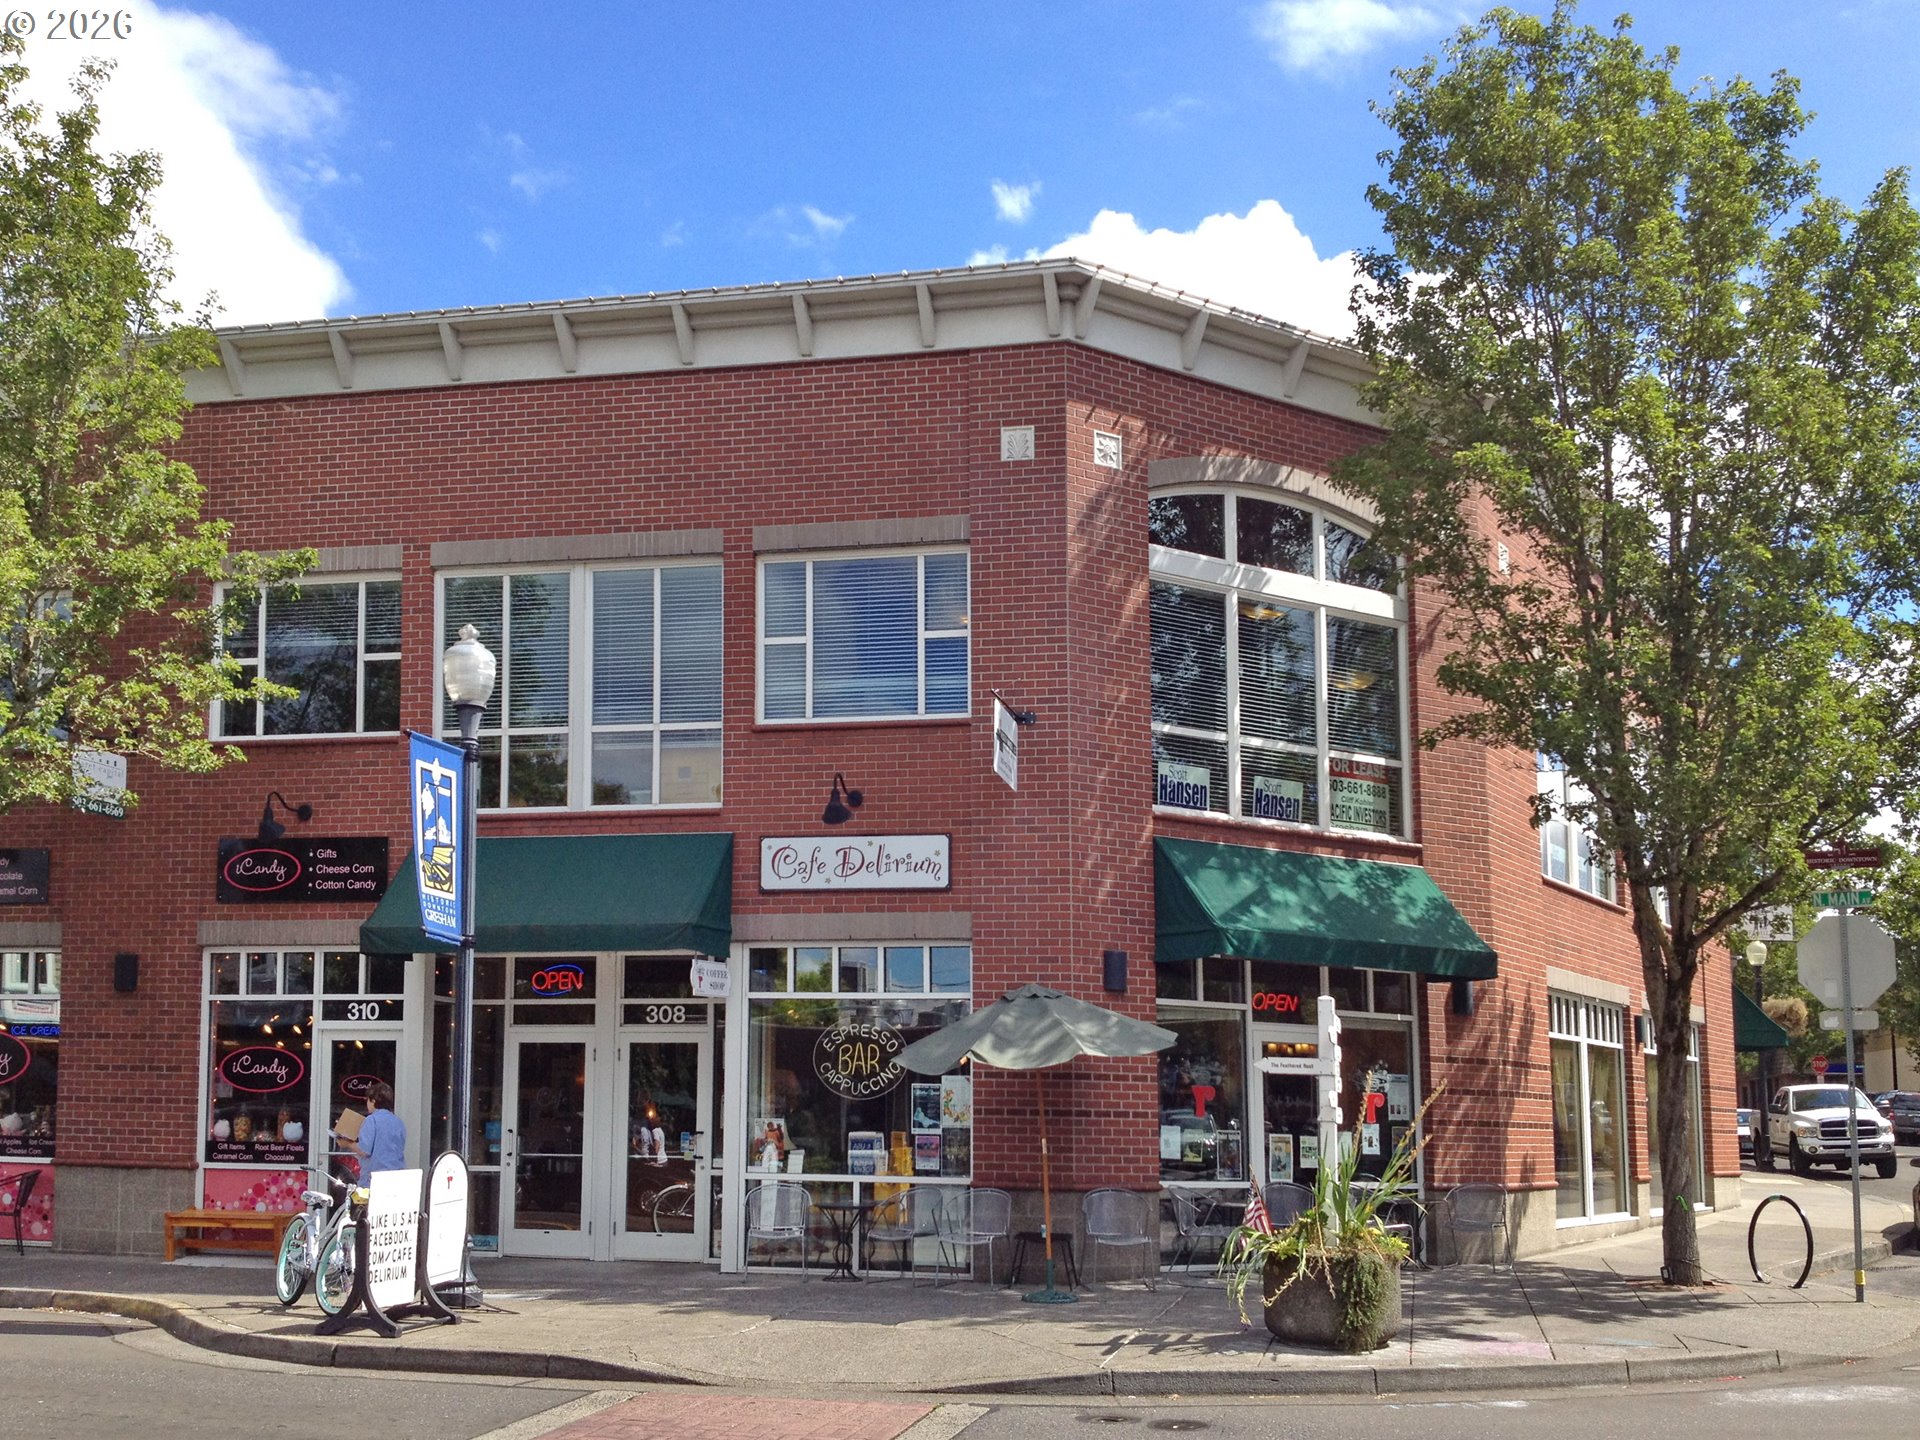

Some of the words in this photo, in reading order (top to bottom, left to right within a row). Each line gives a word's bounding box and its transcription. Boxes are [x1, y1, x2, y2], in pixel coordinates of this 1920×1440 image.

[1168, 765, 1188, 780] Scott
[1352, 760, 1386, 780] LEASE
[1159, 774, 1208, 807] Hansen
[1263, 779, 1282, 795] Scott
[1255, 788, 1300, 819] Hansen
[1330, 803, 1352, 821] ACIFIC
[1354, 806, 1387, 827] INVESTORS
[316, 849, 338, 859] Gifts
[771, 844, 827, 884] Cafe
[833, 843, 941, 883] Delirium
[235, 857, 287, 882] iCandy
[315, 864, 350, 874] Cheese
[352, 863, 375, 873] Corn
[17, 886, 38, 896] Corn
[315, 879, 345, 890] Cotton
[346, 879, 377, 891] Candy
[1827, 890, 1860, 907] MAIN
[424, 908, 456, 928] GRESHAM
[531, 970, 584, 991] OPEN
[706, 969, 729, 979] COFFEE
[347, 1002, 380, 1020] 310
[1252, 992, 1299, 1012] OPEN
[646, 1005, 686, 1024] 308
[10, 1025, 27, 1035] ICE
[29, 1026, 60, 1036] CREA
[822, 1023, 899, 1052] ESPRESSO
[838, 1042, 880, 1076] BAR
[232, 1055, 288, 1084] iCandy
[820, 1061, 901, 1096] CAPPUCCINO
[347, 1079, 373, 1091] iCand
[218, 1142, 229, 1150] Gift
[255, 1143, 270, 1151] Root
[270, 1143, 286, 1151] Beer
[212, 1152, 238, 1160] Caramel
[264, 1153, 295, 1161] Chocolate
[371, 1214, 388, 1229] LIKE
[407, 1211, 418, 1224] AT
[369, 1265, 407, 1284] DELIRIUM
